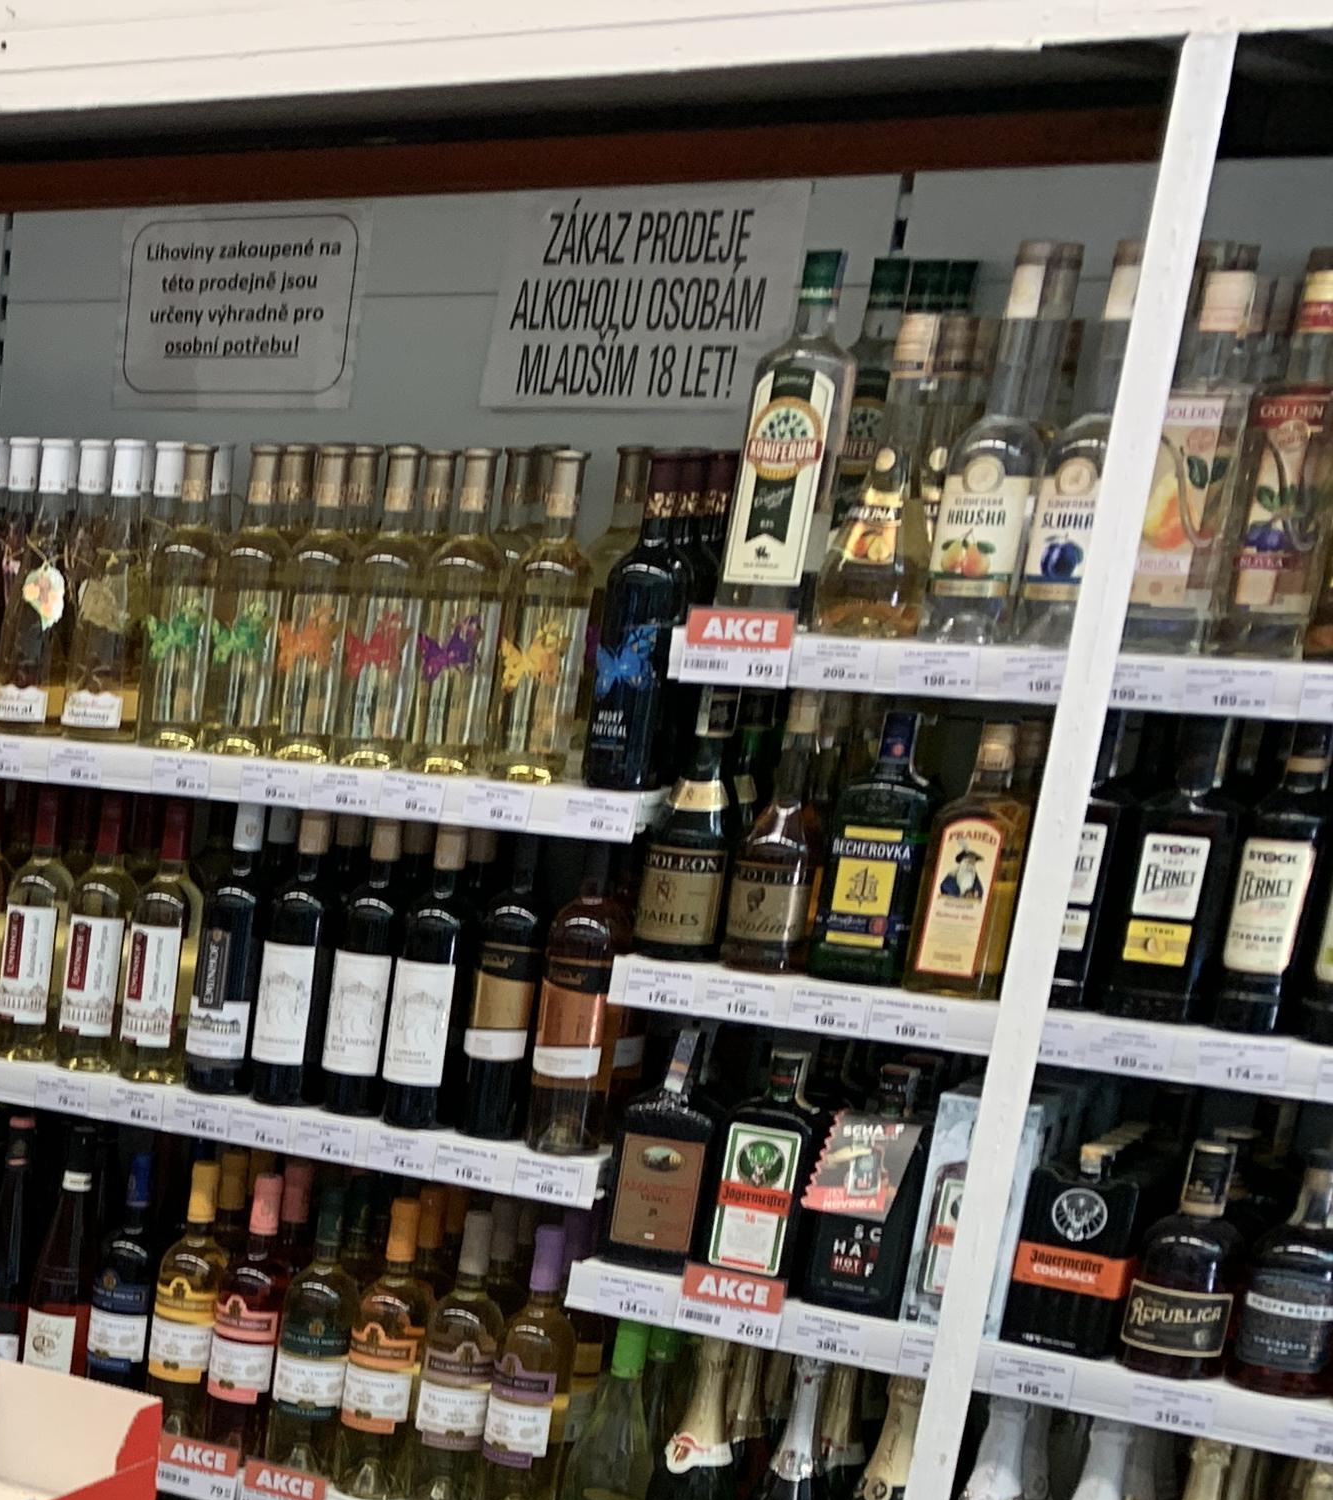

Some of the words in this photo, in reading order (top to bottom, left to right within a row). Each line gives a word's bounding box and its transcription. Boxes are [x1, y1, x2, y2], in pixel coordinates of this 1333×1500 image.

[543, 197, 632, 266] ZÁKAZ
[634, 208, 755, 265] PRODEJE
[147, 241, 214, 264] Lihoviny
[219, 238, 314, 262] zakoupené
[319, 241, 341, 257] na
[162, 274, 194, 293] této
[199, 271, 277, 295] prodejně
[280, 271, 318, 294] jsou
[509, 278, 644, 331] ALKOHOLU
[646, 262, 767, 331] OSOBÁM
[150, 305, 203, 327] určeny
[208, 303, 289, 326] výhradně
[293, 306, 324, 324] pro
[164, 336, 219, 355] osobní
[223, 333, 300, 357] potřebu!
[516, 329, 639, 396] MLADŠÍM
[648, 344, 677, 397] 18
[680, 345, 738, 399] LET!
[1261, 404, 1324, 419] GOLDEN
[748, 440, 818, 464] KONIFERUM
[701, 616, 780, 642] AKCE
[833, 837, 912, 861] BECHEROVKA
[1150, 842, 1202, 857] STOCK
[1247, 850, 1299, 866] STOCK
[1142, 863, 1197, 896] FERNET
[1239, 870, 1295, 906] FERNET
[697, 1273, 771, 1308] AKCE
[170, 1445, 228, 1471] AKCE
[255, 1468, 315, 1500] AKCE
